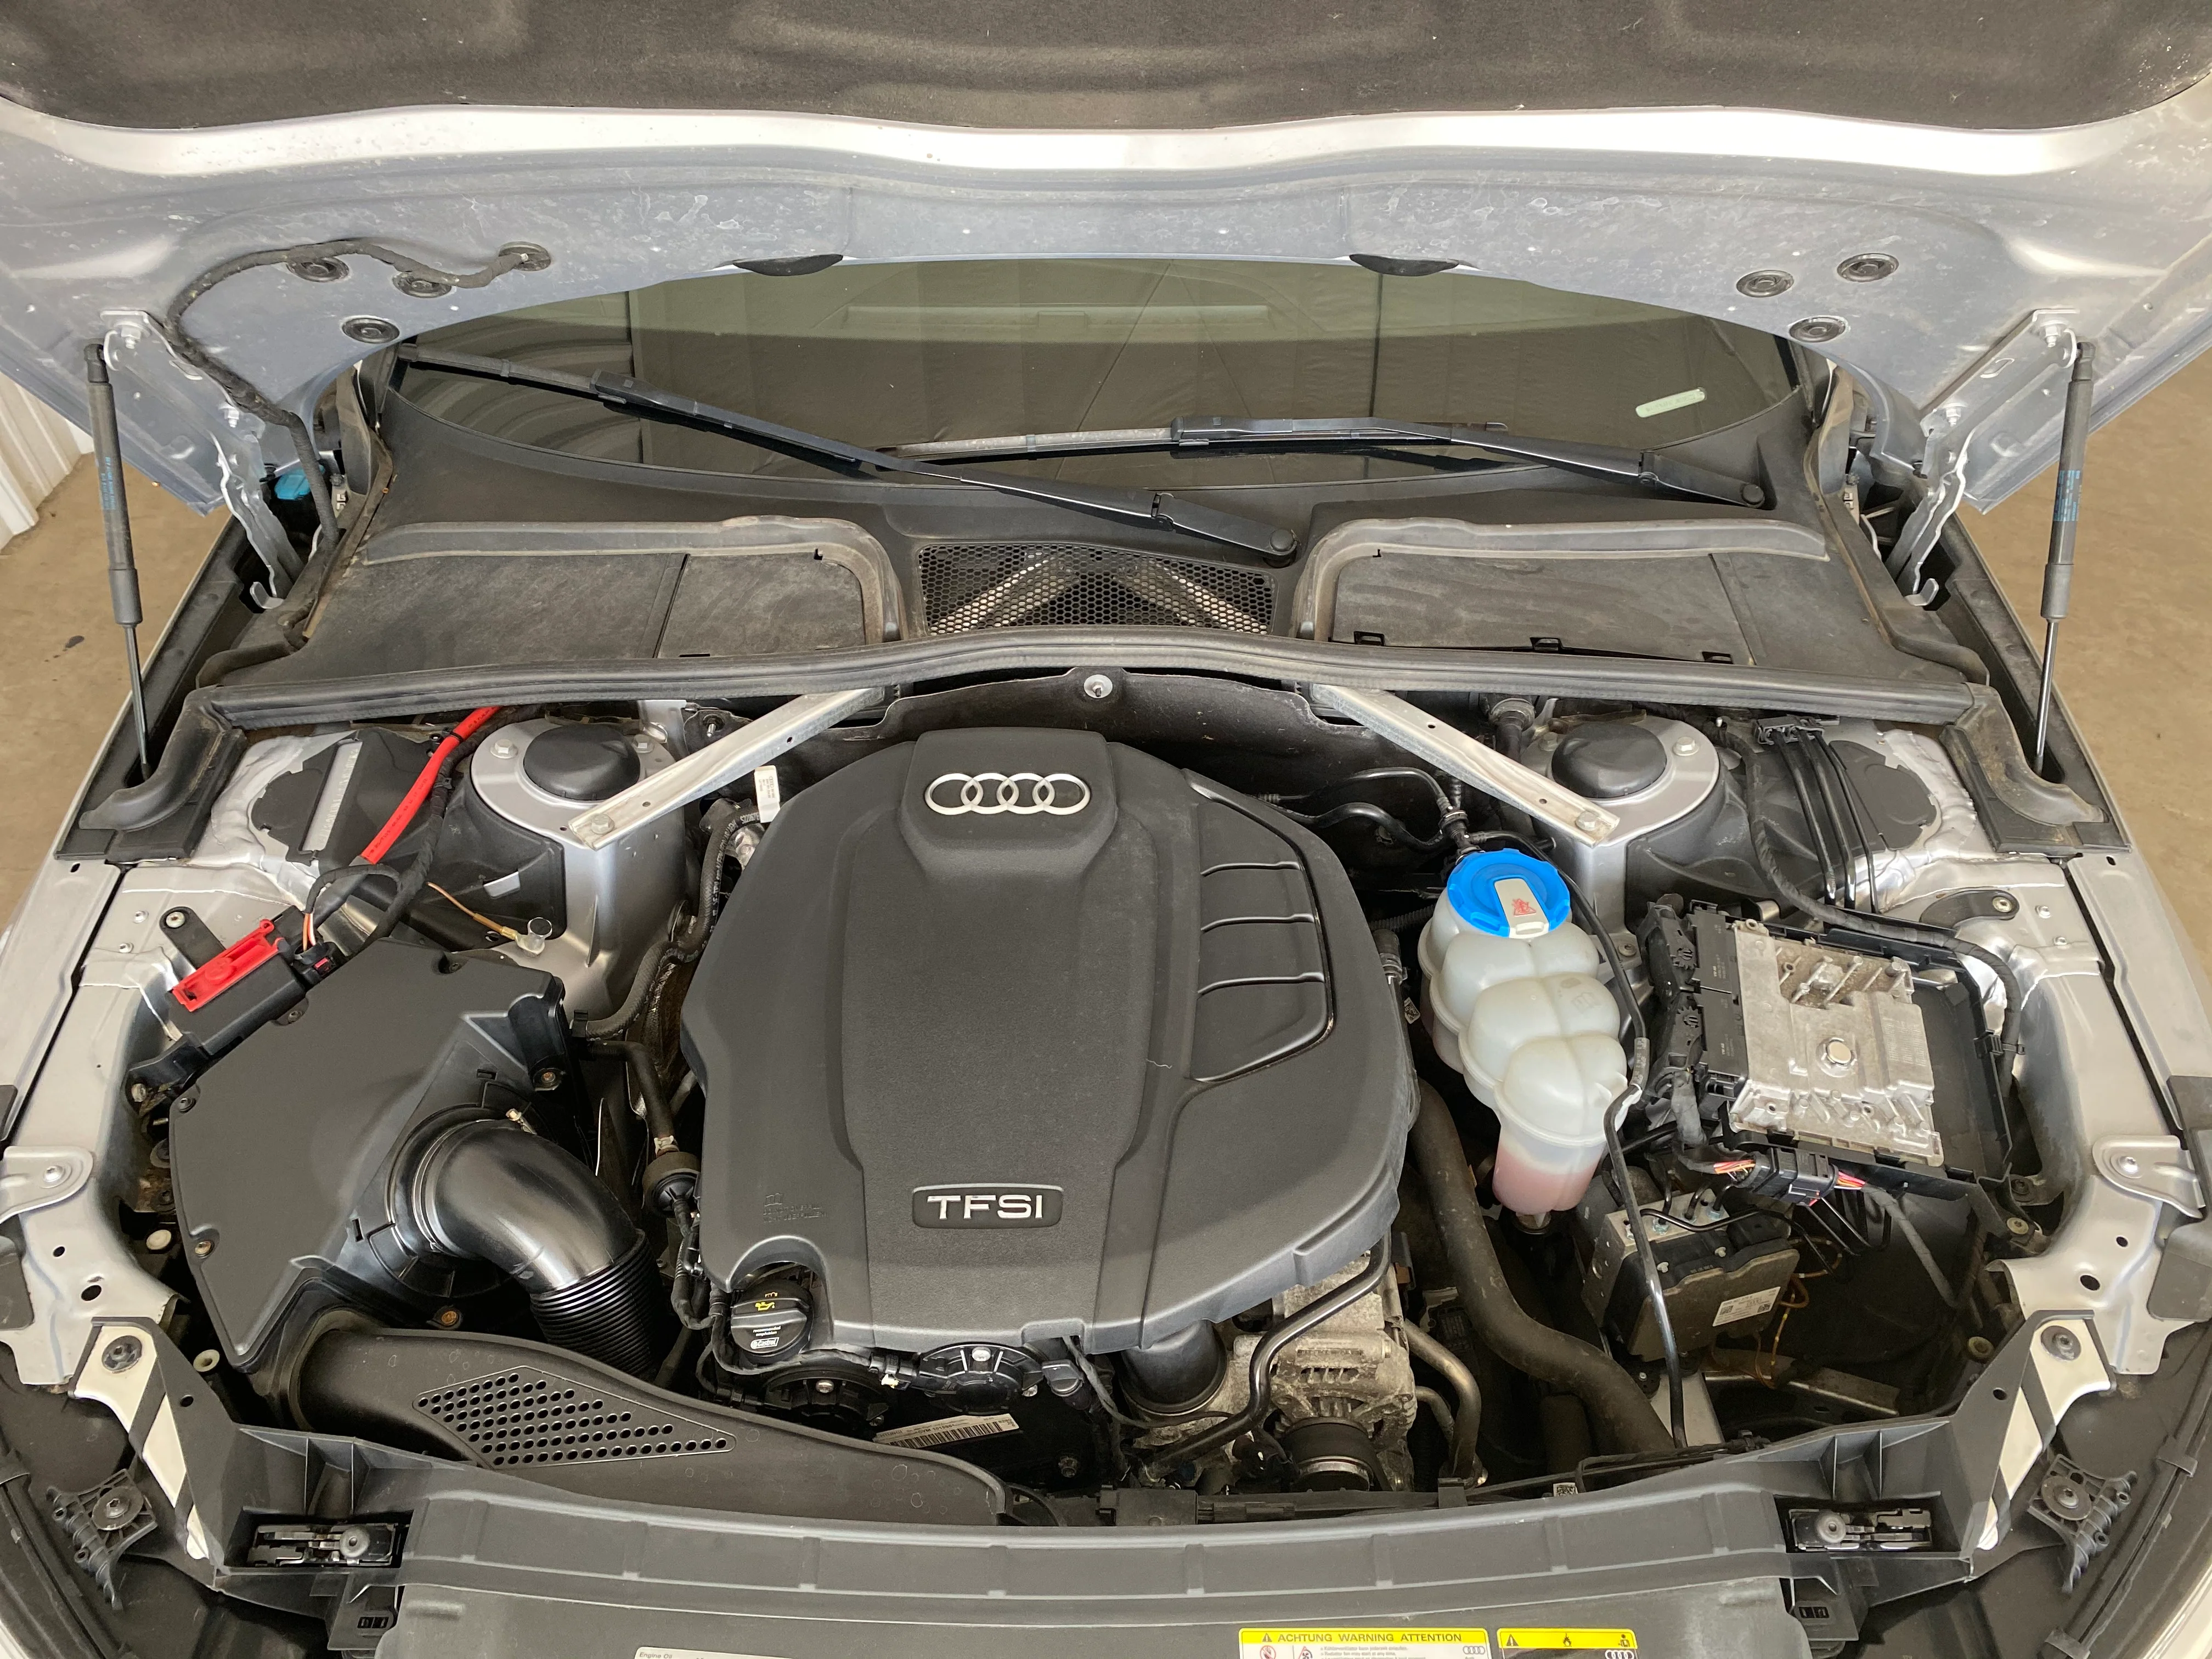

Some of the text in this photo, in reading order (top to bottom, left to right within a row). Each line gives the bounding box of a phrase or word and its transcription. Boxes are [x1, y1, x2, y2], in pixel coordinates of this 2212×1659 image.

[927, 1194, 1043, 1220] TFSI
[757, 1338, 776, 1347] Castrol
[1278, 1633, 1462, 1642] ACHTUNG WARNING ATTENTION
